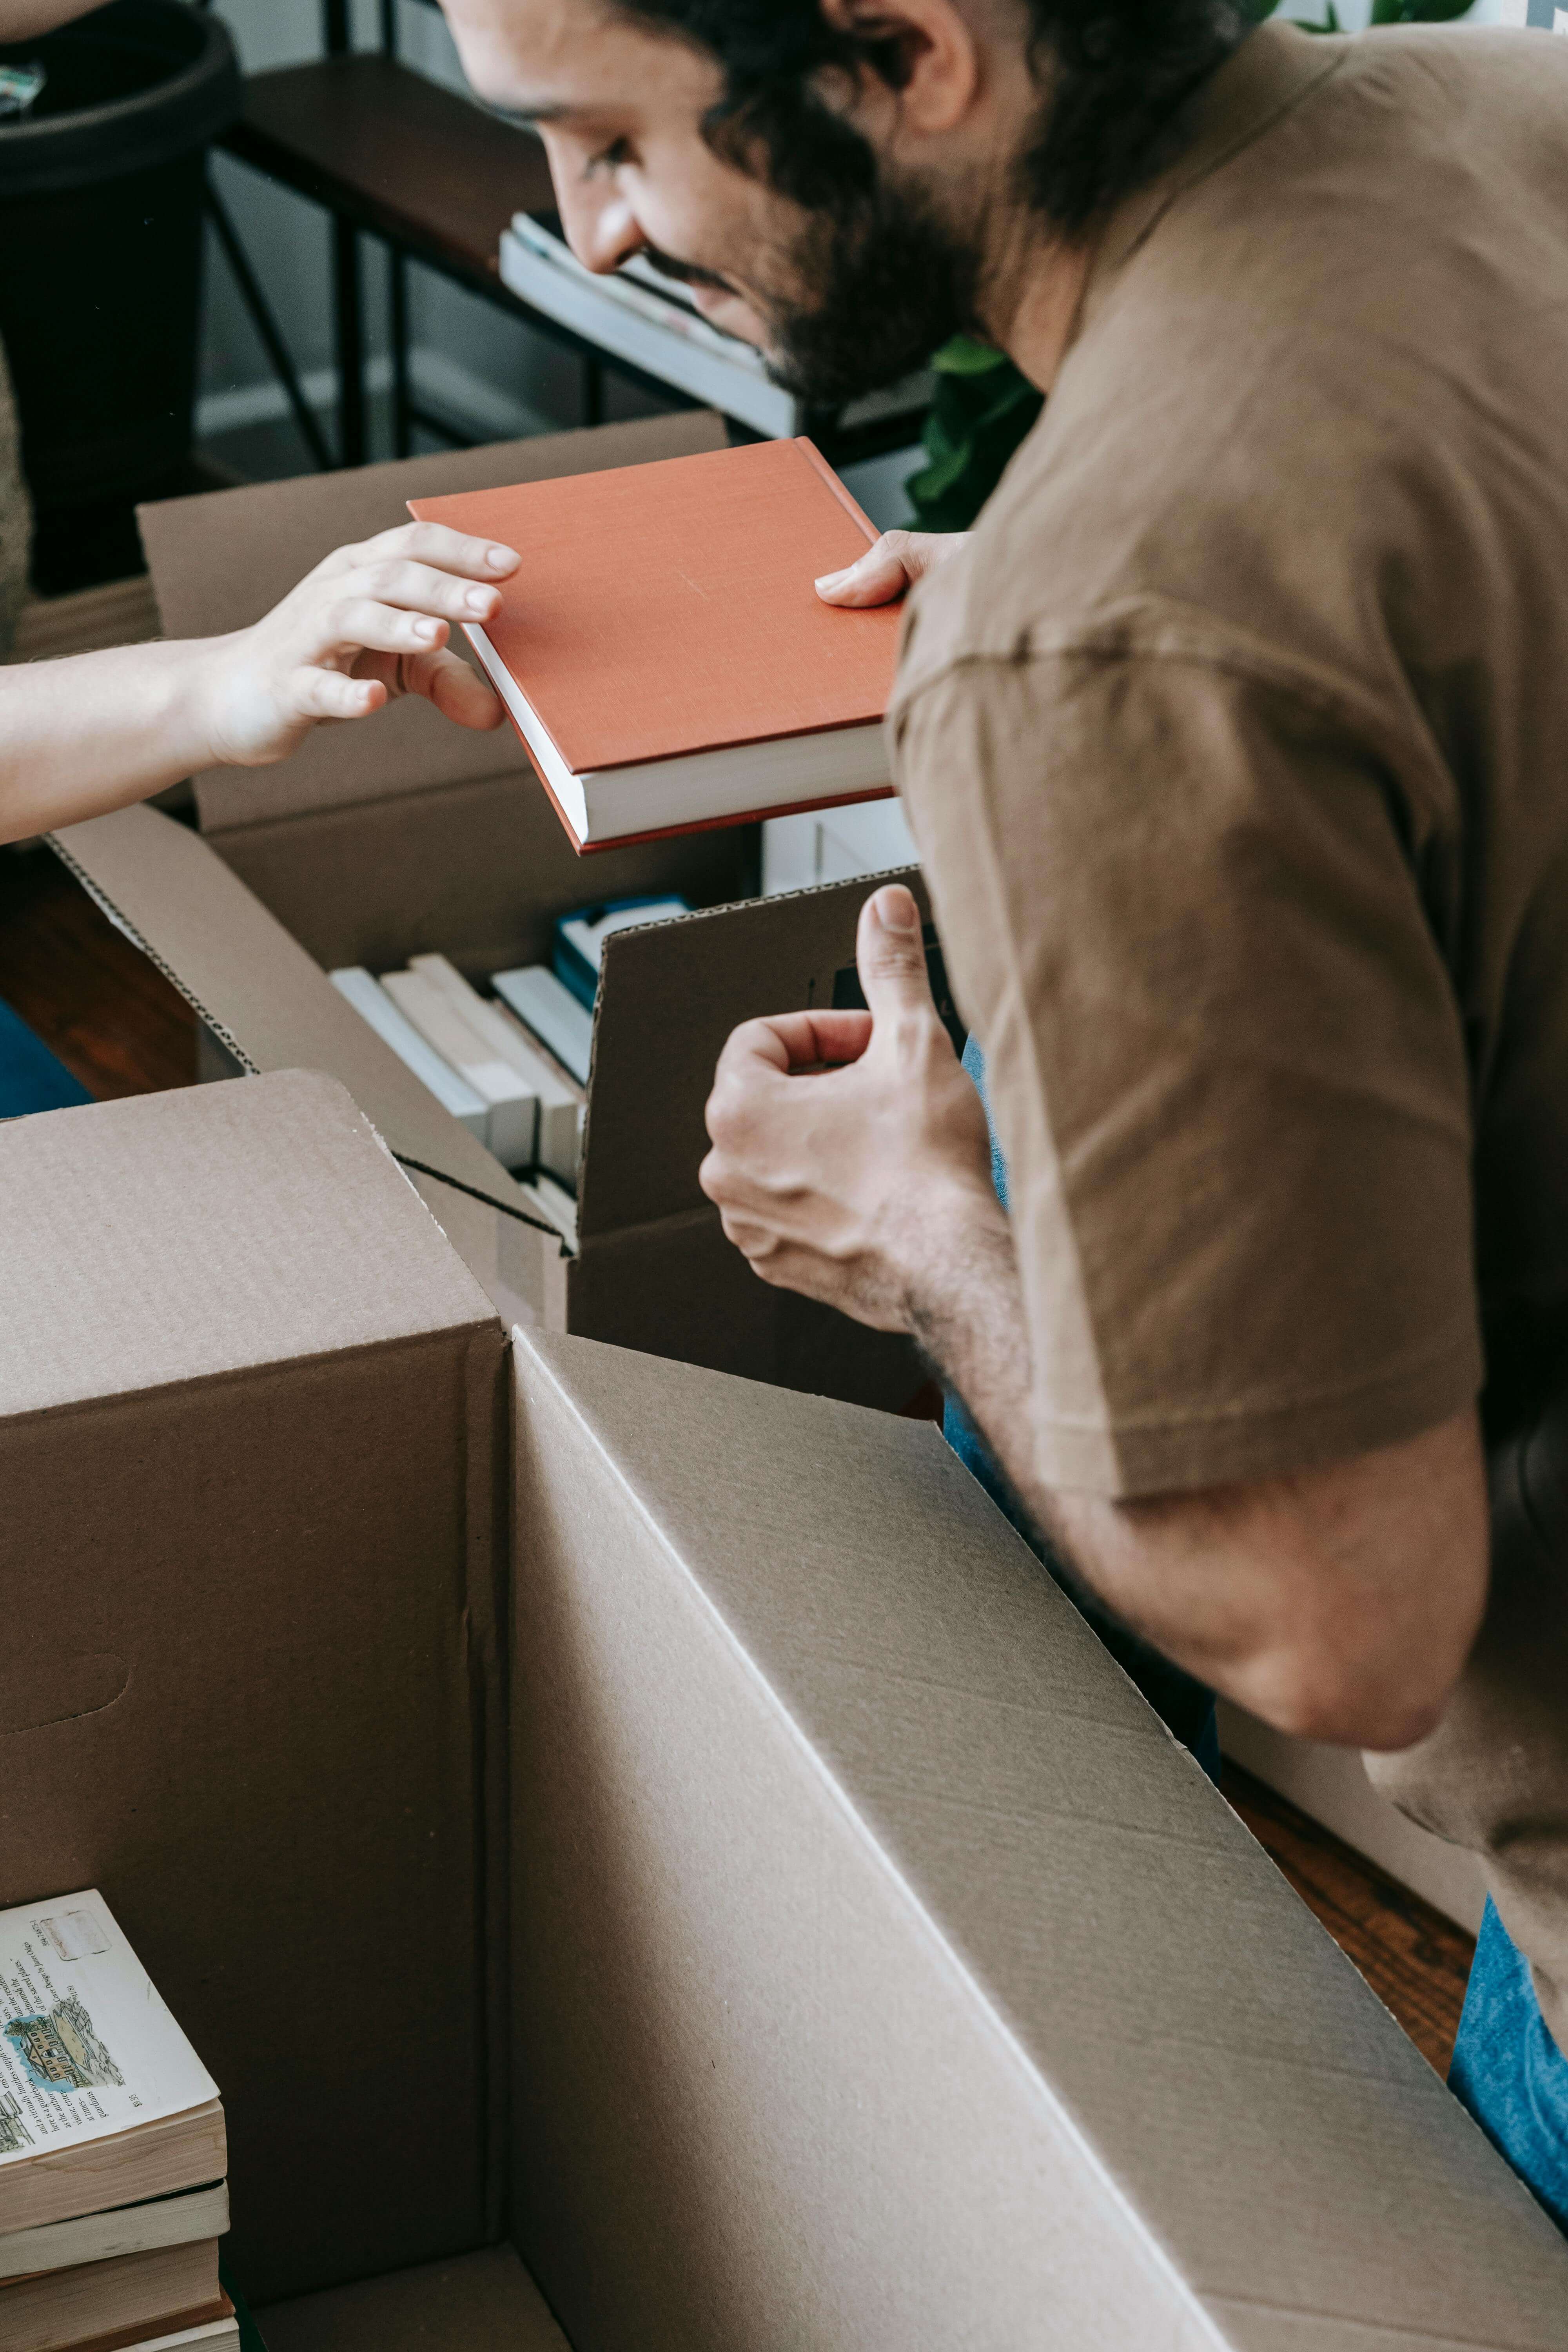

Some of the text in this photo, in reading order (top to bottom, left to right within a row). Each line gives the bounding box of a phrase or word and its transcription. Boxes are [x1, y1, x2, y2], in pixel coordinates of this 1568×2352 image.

[31, 1955, 43, 1967] Janet
[22, 1978, 38, 1994] sacred
[41, 1973, 53, 1989] Design
[9, 1996, 17, 2005] the
[11, 1978, 36, 2014] admonish the
[34, 1996, 43, 2005] the
[50, 1989, 60, 2002] Cover
[13, 2006, 24, 2017] tain
[0, 2053, 14, 2071] supply
[10, 2071, 26, 2095] limitless
[25, 2078, 50, 2108] guidebook
[128, 2094, 143, 2107] $9.95
[22, 2095, 39, 2119] virtually
[48, 2092, 62, 2112] author
[60, 2089, 83, 2125] visitor, enter-
[87, 2091, 109, 2118] guardians
[49, 2119, 60, 2132] here
[58, 2113, 68, 2122] the
[35, 2124, 48, 2135] and
